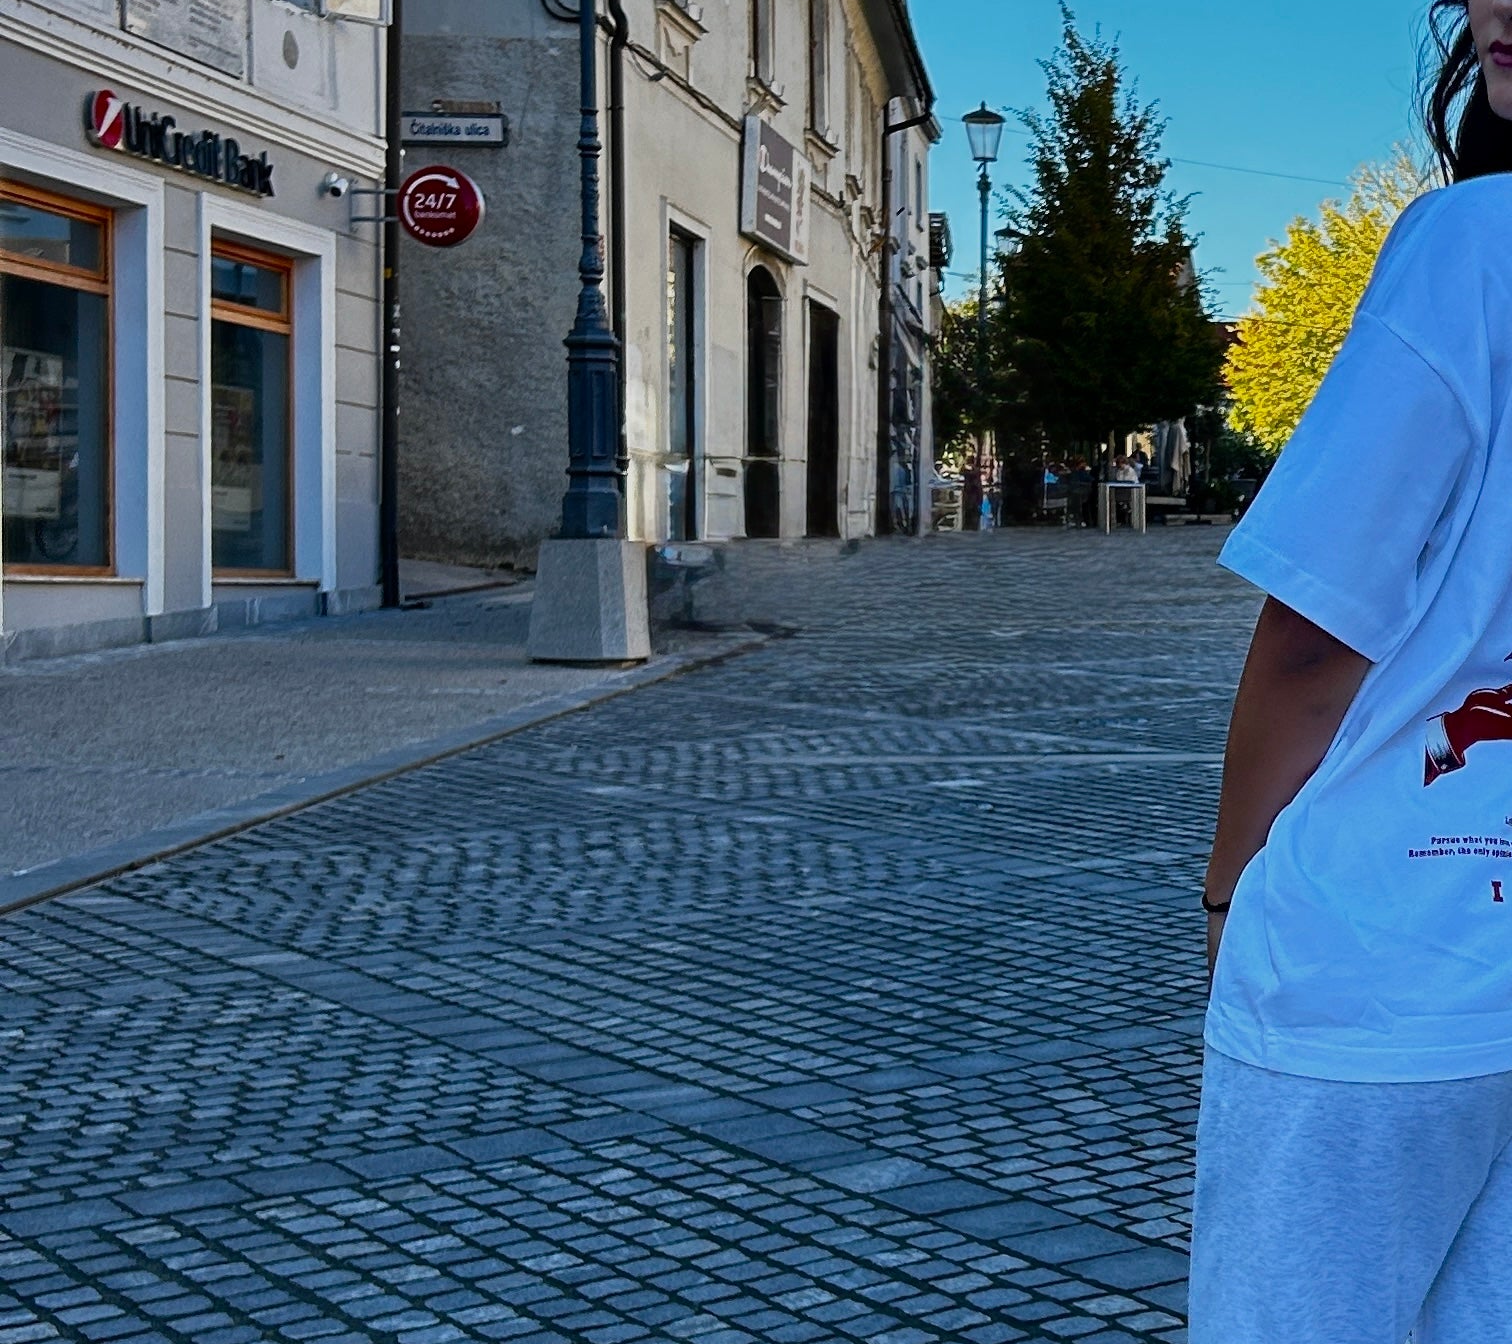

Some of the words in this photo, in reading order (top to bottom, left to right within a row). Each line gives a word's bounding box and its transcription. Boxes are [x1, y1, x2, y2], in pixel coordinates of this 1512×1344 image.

[464, 122, 490, 136] ulica
[122, 101, 223, 179] UniCredit
[224, 137, 275, 197] Bank
[414, 192, 457, 210] 24/7
[1490, 880, 1504, 903] I
